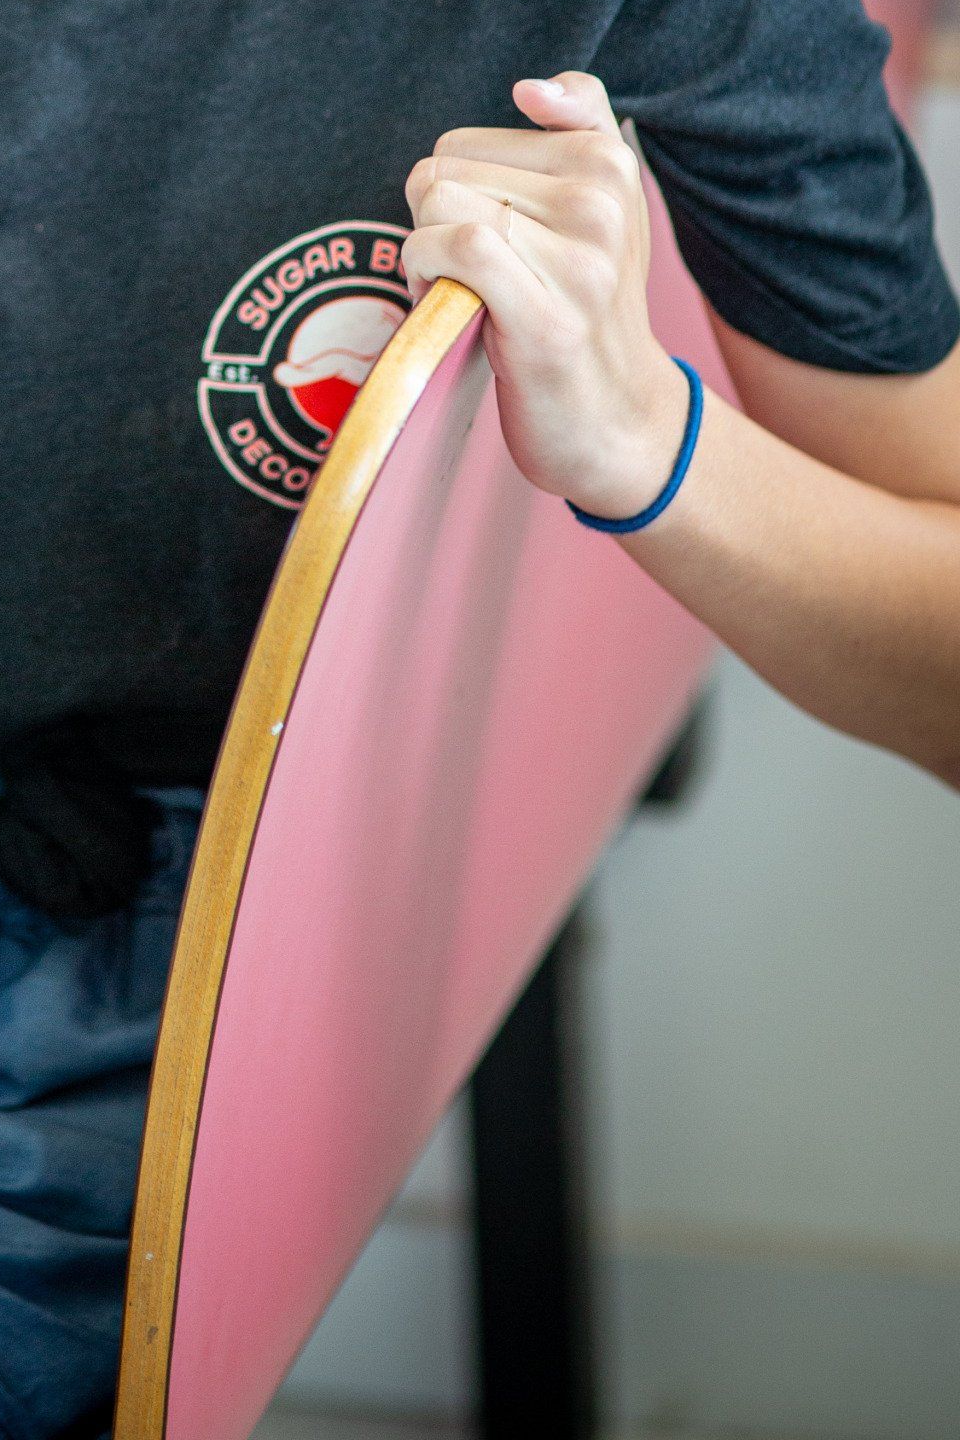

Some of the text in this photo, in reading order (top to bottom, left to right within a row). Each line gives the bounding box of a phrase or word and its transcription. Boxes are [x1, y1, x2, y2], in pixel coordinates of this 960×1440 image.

[237, 237, 407, 331] SUGAR B
[228, 418, 311, 492] DECO
